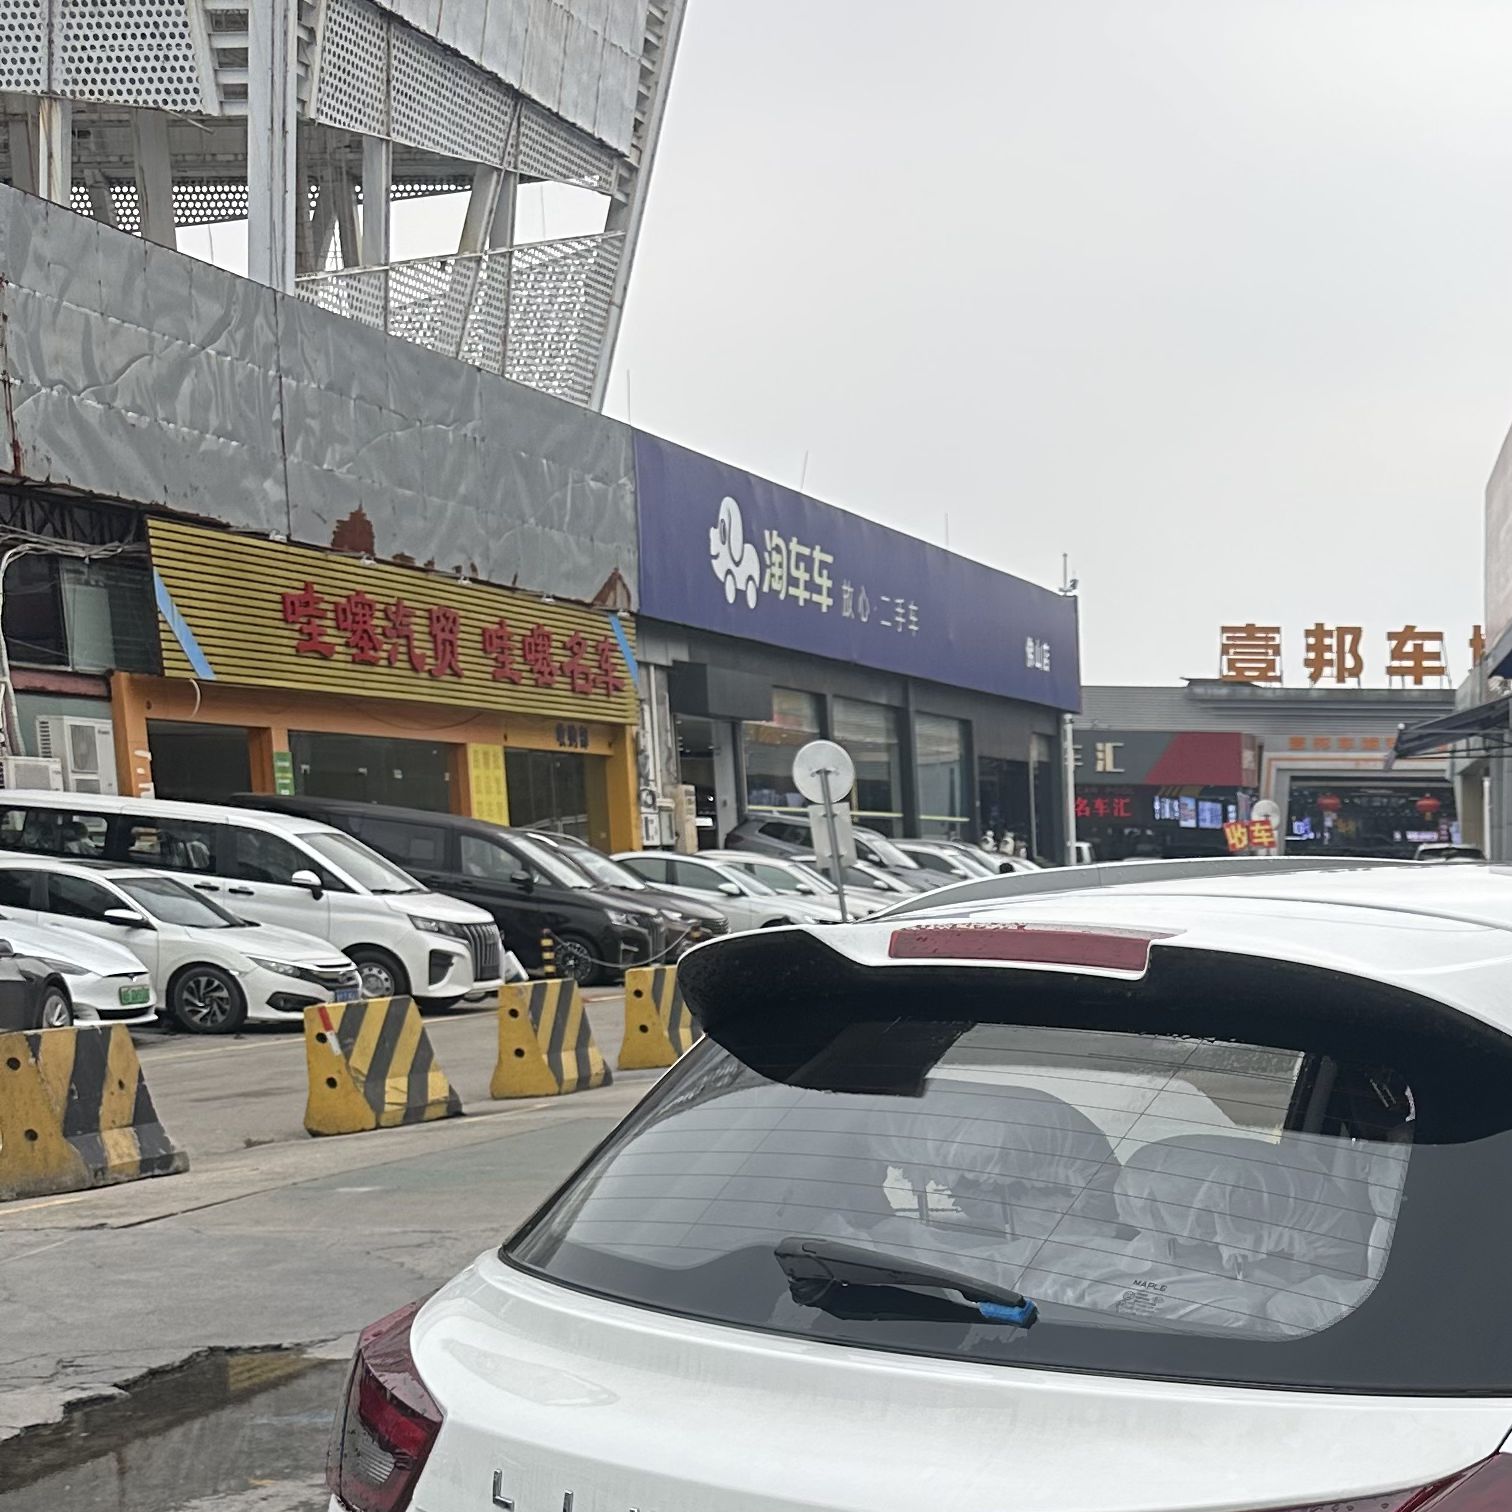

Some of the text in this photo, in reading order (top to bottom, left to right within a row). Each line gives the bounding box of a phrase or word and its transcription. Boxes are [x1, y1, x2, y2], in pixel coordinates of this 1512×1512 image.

[762, 528, 834, 613] 淘车车
[281, 580, 626, 698] 哇噻汽贸 哇噻名车
[1225, 821, 1277, 849] 收车
